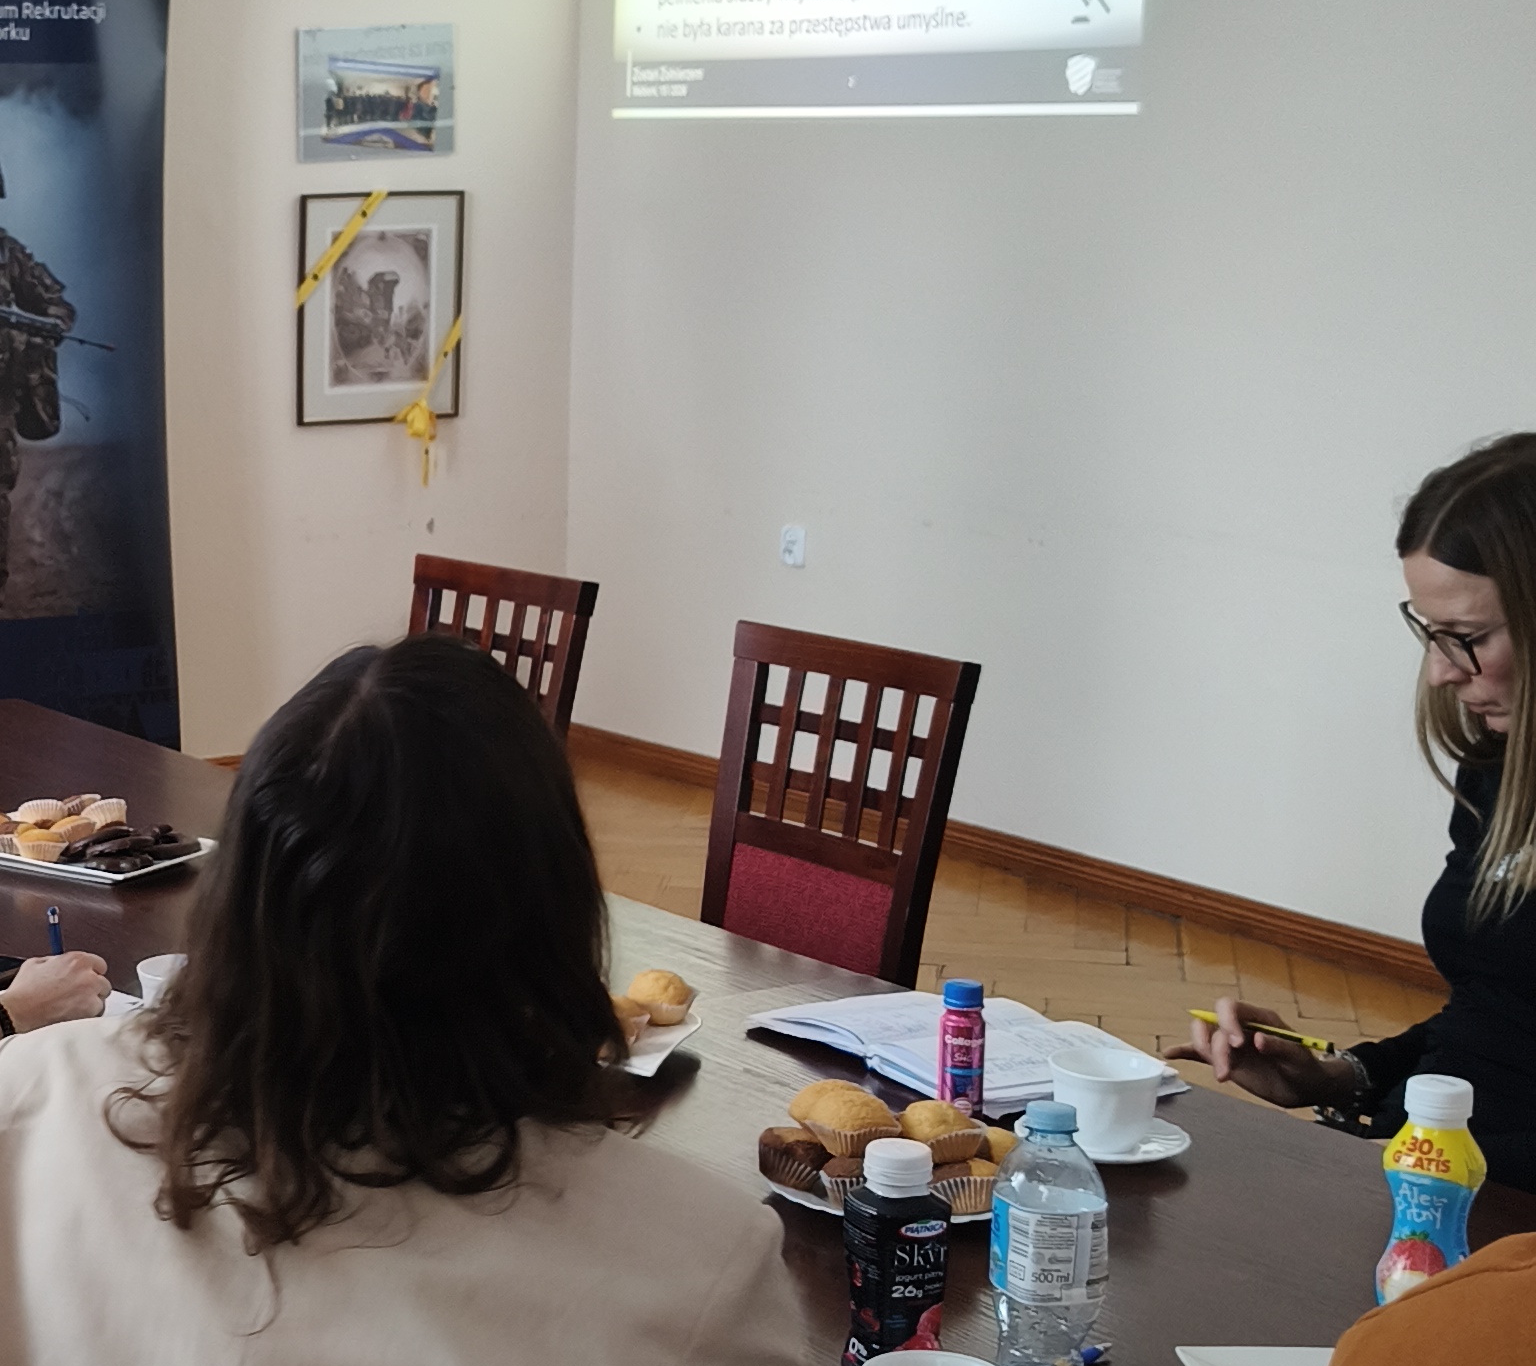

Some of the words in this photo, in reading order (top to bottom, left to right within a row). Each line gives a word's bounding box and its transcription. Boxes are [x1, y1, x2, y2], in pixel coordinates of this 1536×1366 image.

[22, 1, 107, 24] Rekrutacji
[657, 20, 678, 39] nie
[683, 17, 712, 43] była
[716, 16, 764, 37] karana
[769, 20, 785, 36] za
[1393, 1149, 1451, 1174] GATIS
[894, 1243, 947, 1268] Skyr
[1031, 1272, 1054, 1283] 500
[1056, 1272, 1070, 1283] ml
